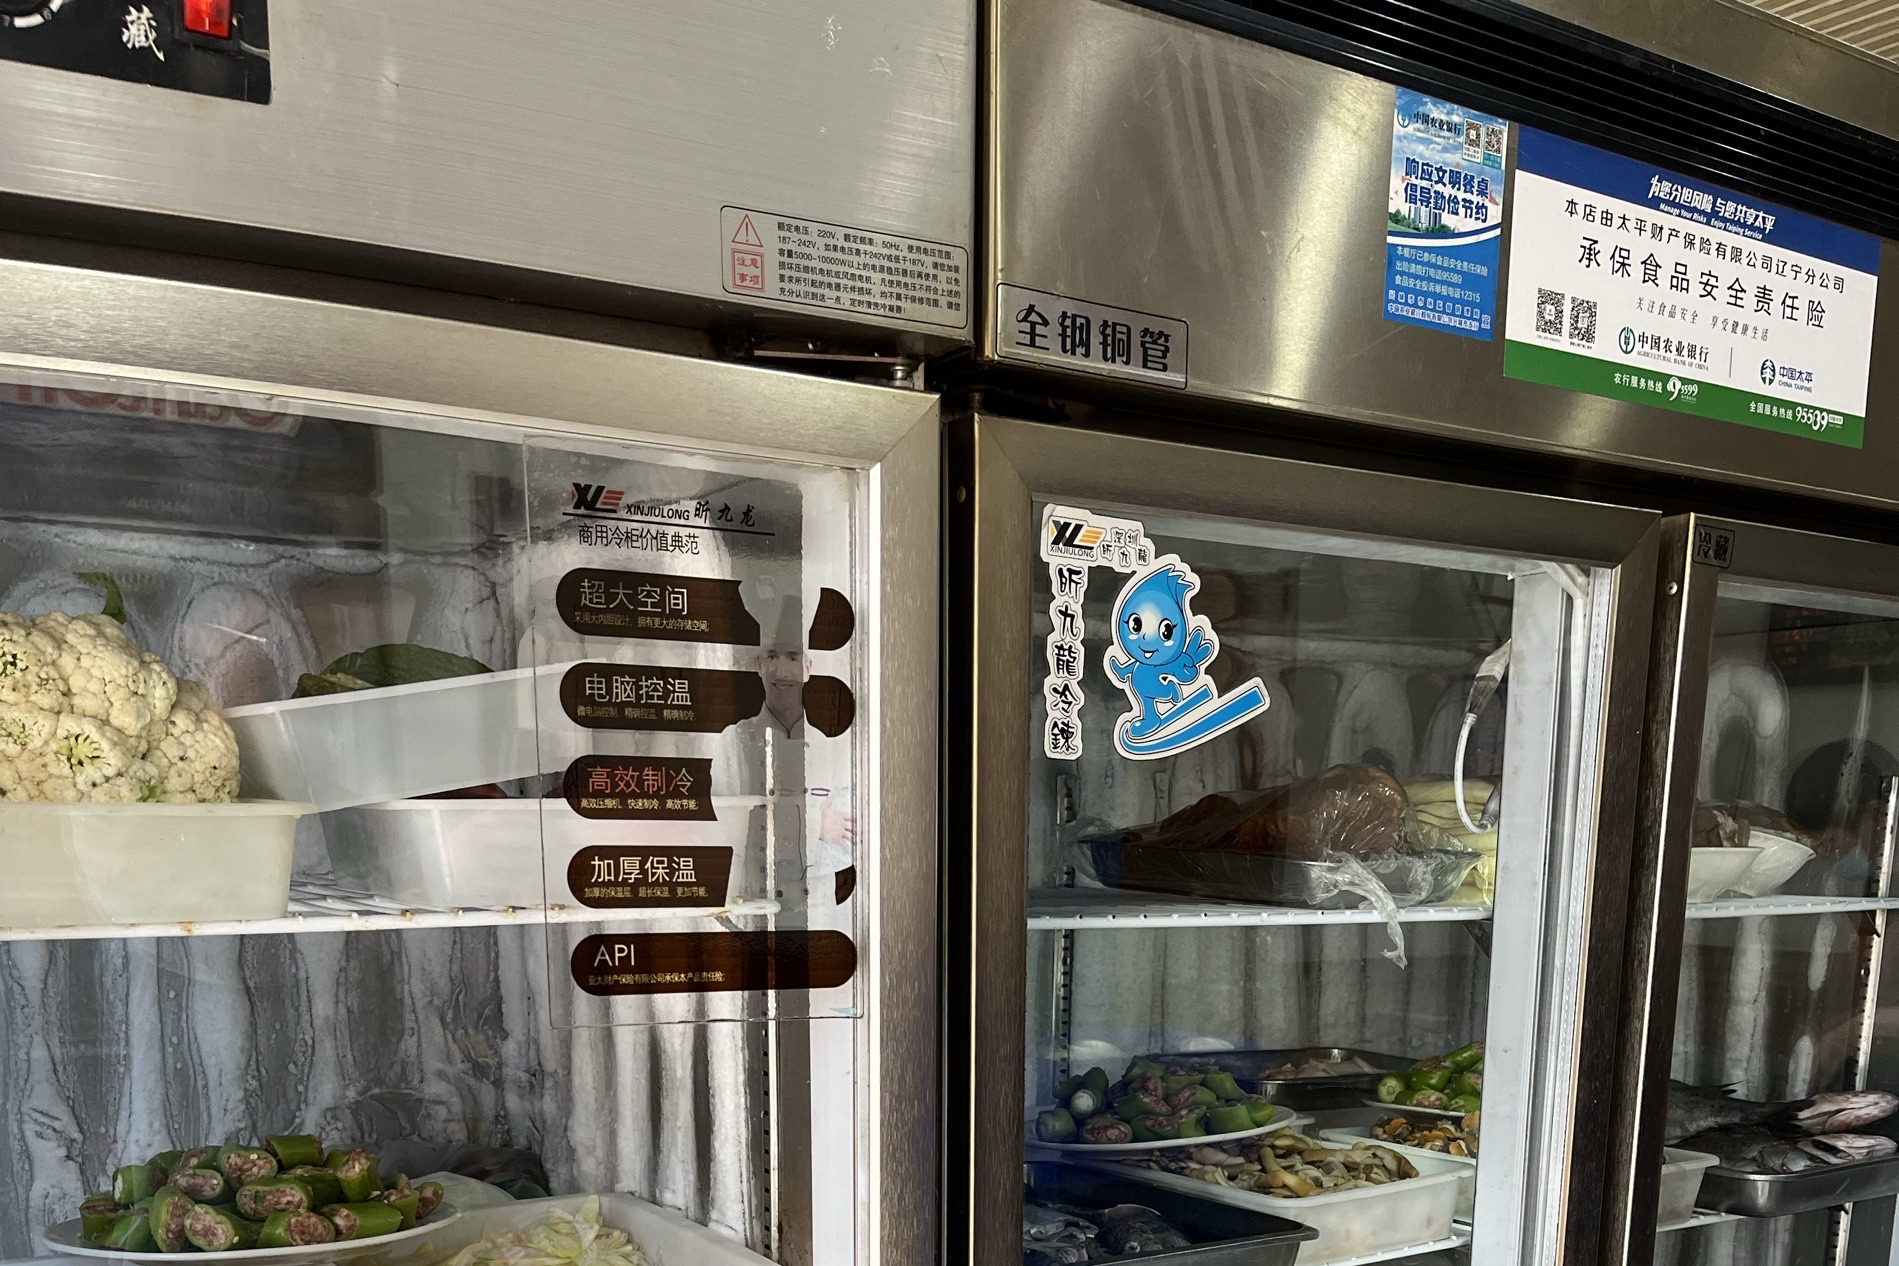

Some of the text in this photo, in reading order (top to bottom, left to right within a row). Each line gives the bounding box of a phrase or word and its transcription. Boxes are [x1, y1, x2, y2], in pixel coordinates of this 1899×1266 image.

[122, 4, 165, 62] 藏
[1413, 111, 1461, 136] 中国农业银行
[1404, 155, 1490, 199] 响应文明餐桌
[1403, 182, 1489, 224] 倡导勤俭节约
[1648, 174, 1776, 234] 为您分担风险 与您共享太平
[1659, 202, 1763, 240] Manage Your Risks Enjoy Taiping Service
[1564, 198, 1845, 294] 本店由太平财产保险有限公司辽宁分公司
[1578, 236, 1826, 329] 承保食品安全责任险
[1636, 296, 1769, 342] 关注食品安全 享受健康生活
[1015, 303, 1172, 373] 全钢铜管
[1637, 331, 1710, 363] 中国农业银行
[1613, 372, 1663, 394] 农行服务热线
[1778, 366, 1813, 384] 中国太平
[1778, 379, 1812, 393] CHINA TAIPING
[1749, 401, 1793, 421] 全国服务热线
[1795, 406, 1828, 432] 95589
[625, 500, 756, 528] XINJIULONG 昕九龙
[577, 522, 700, 556] 商用冷柜价值典范
[1050, 545, 1095, 559] XINJIULONG
[579, 577, 689, 616] 超大空间
[584, 672, 693, 706] 电脑控温
[587, 766, 694, 796] 高效制冷
[590, 855, 698, 884] 加厚保温
[593, 943, 636, 967] API
